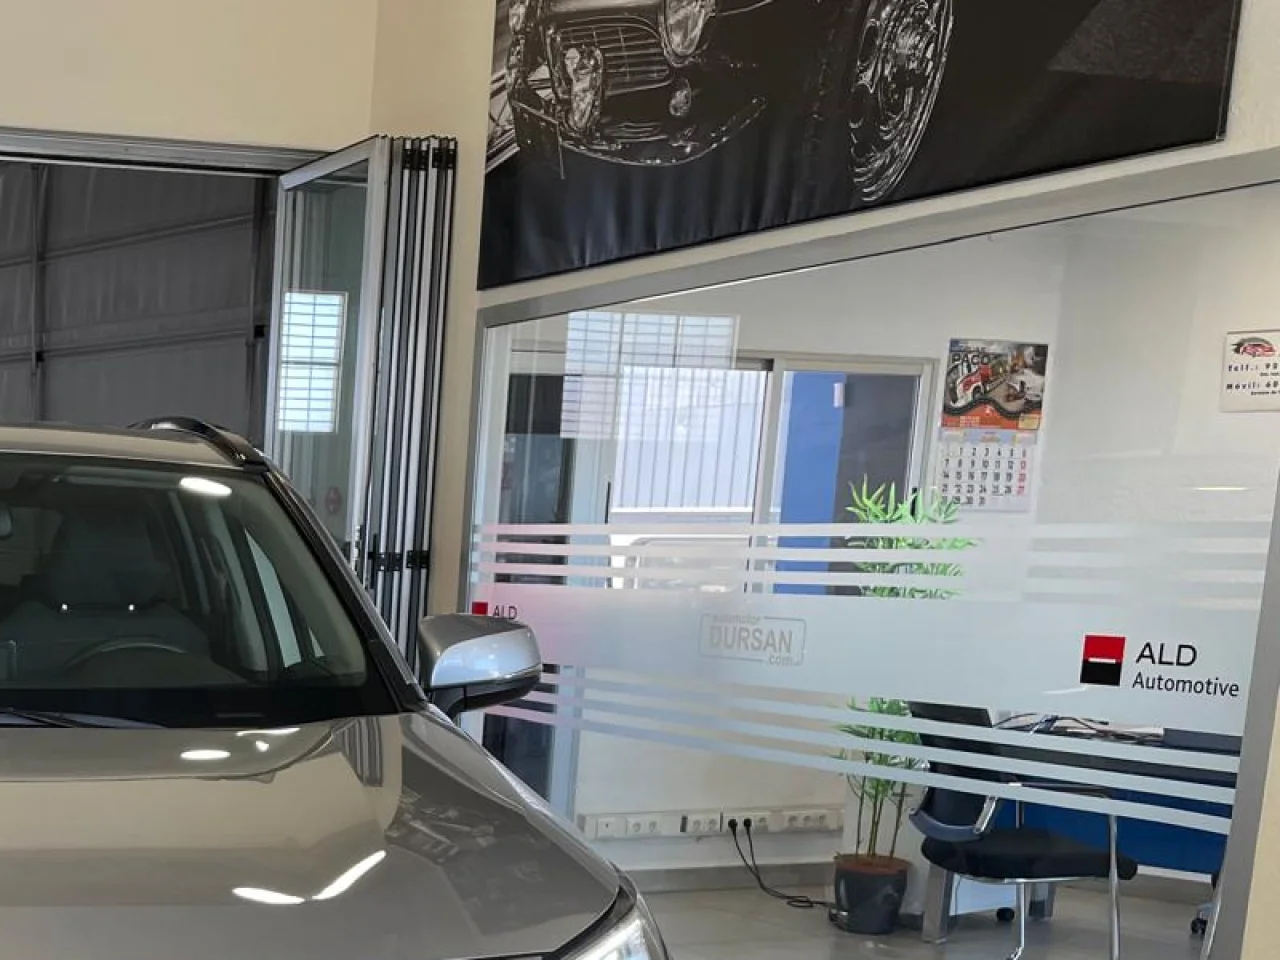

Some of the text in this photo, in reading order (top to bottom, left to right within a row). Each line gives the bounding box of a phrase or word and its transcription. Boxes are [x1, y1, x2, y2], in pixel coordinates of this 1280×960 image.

[709, 624, 793, 654] DURSAN
[1136, 641, 1198, 667] ALD
[1132, 671, 1240, 697] Automotive
